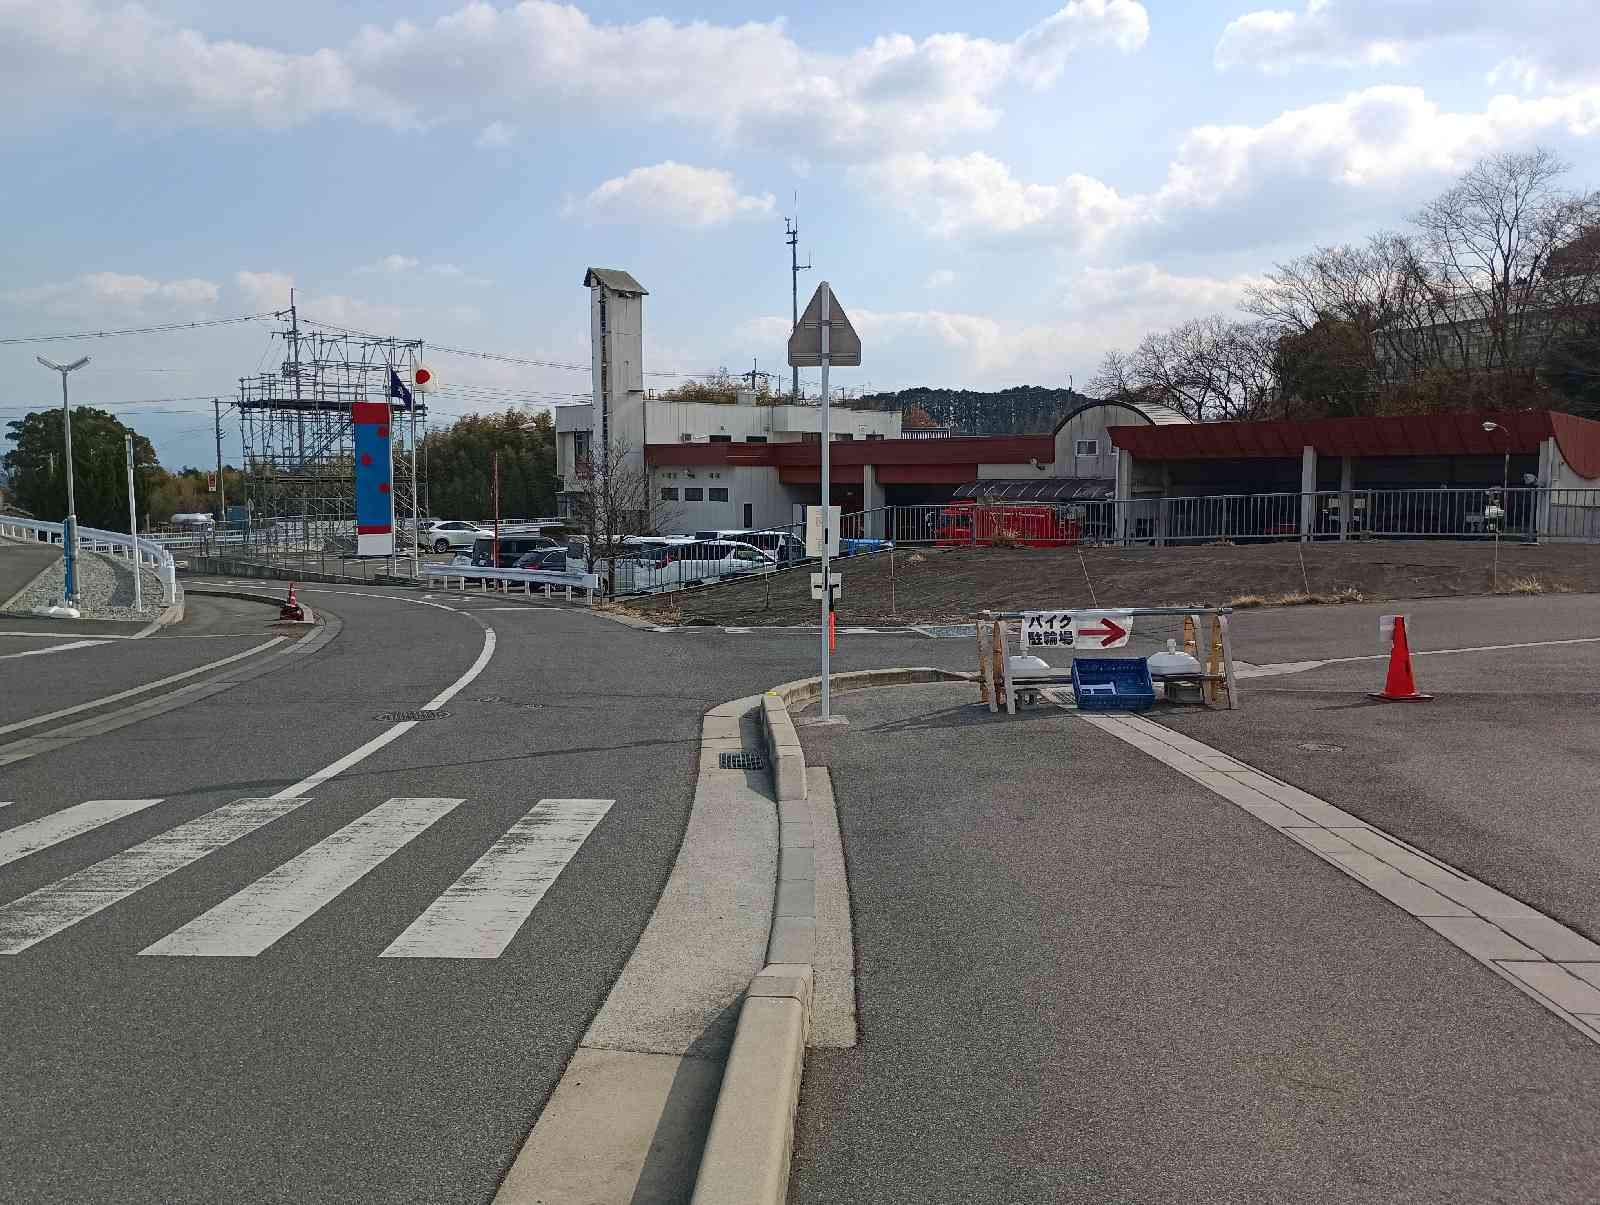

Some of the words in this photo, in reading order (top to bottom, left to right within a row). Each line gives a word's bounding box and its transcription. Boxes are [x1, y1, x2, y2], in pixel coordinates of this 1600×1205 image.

[1028, 615, 1072, 629] バイク
[1027, 630, 1073, 645] 駐輪場
